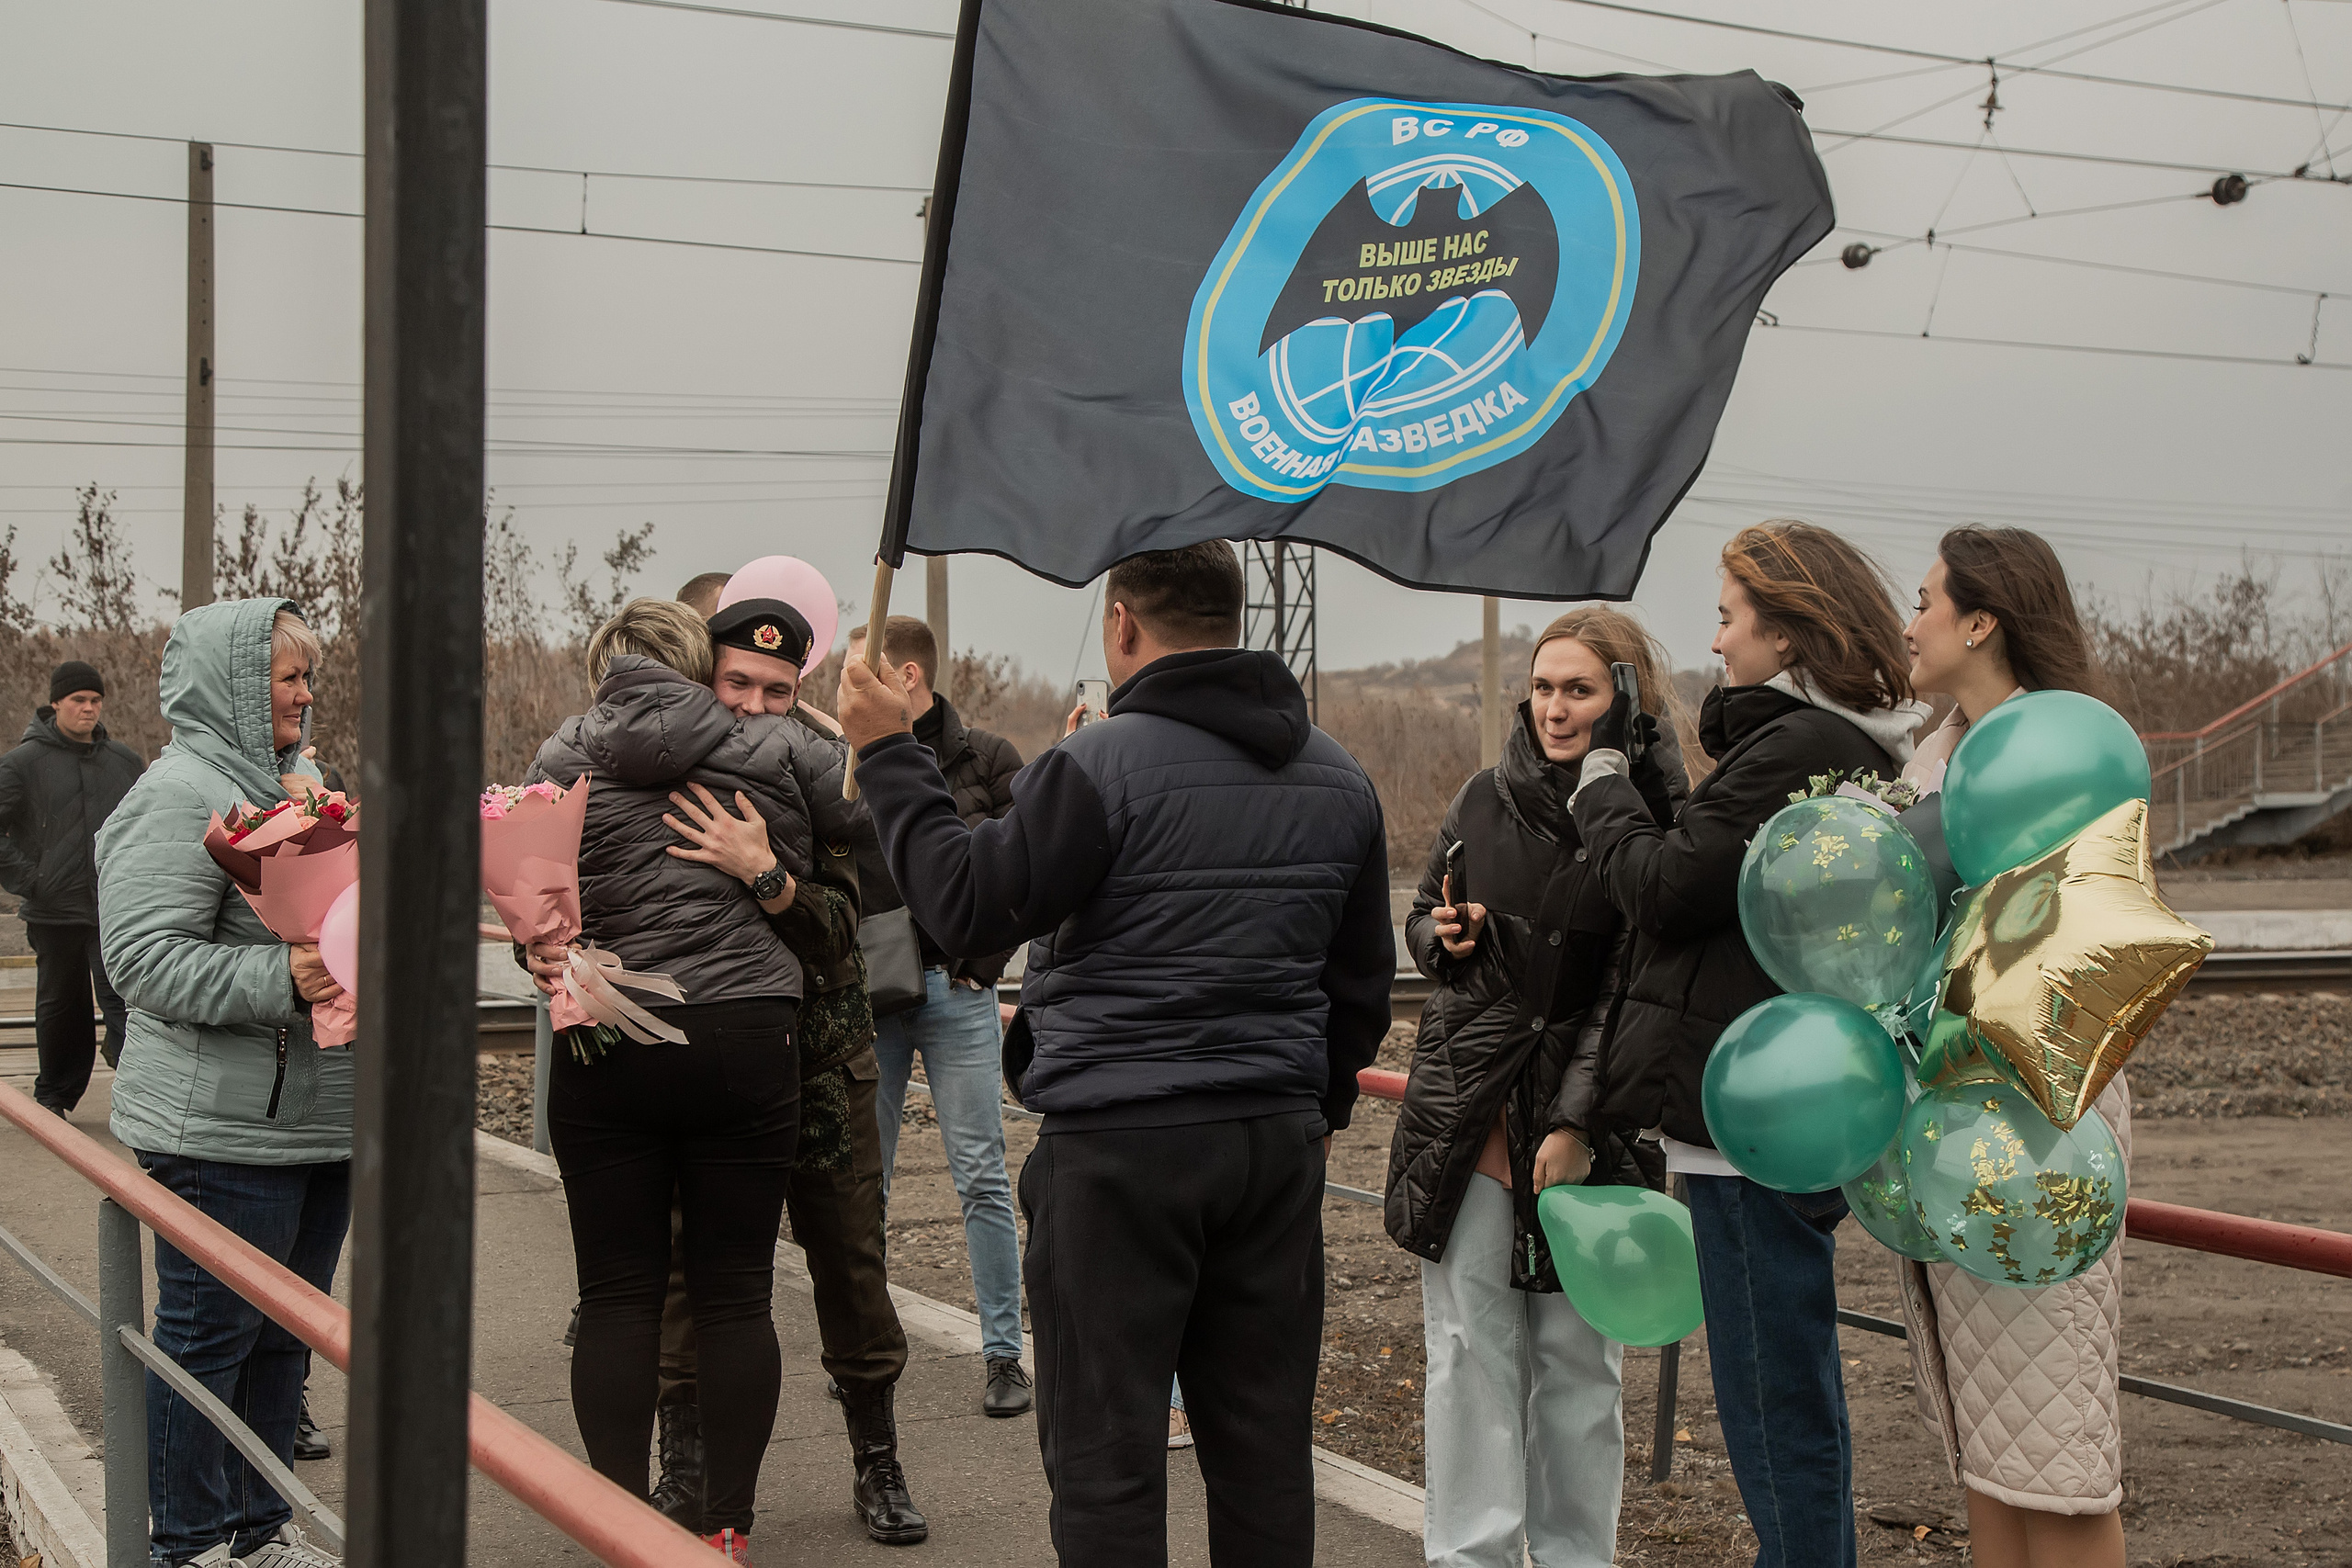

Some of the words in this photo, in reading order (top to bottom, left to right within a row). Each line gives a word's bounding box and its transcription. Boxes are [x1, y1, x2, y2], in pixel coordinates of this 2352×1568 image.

[1392, 117, 1454, 146] ВС
[1464, 122, 1530, 148] РФ
[1359, 237, 1438, 268] ВЫШЕ
[1442, 230, 1489, 260] НАС
[1322, 272, 1422, 303] ТОЛЬКО
[1425, 256, 1520, 293] ЗВЕЗДЫ
[1227, 390, 1340, 479] ВОЕННАЯ
[1338, 380, 1530, 464] АЗВЕДКА
